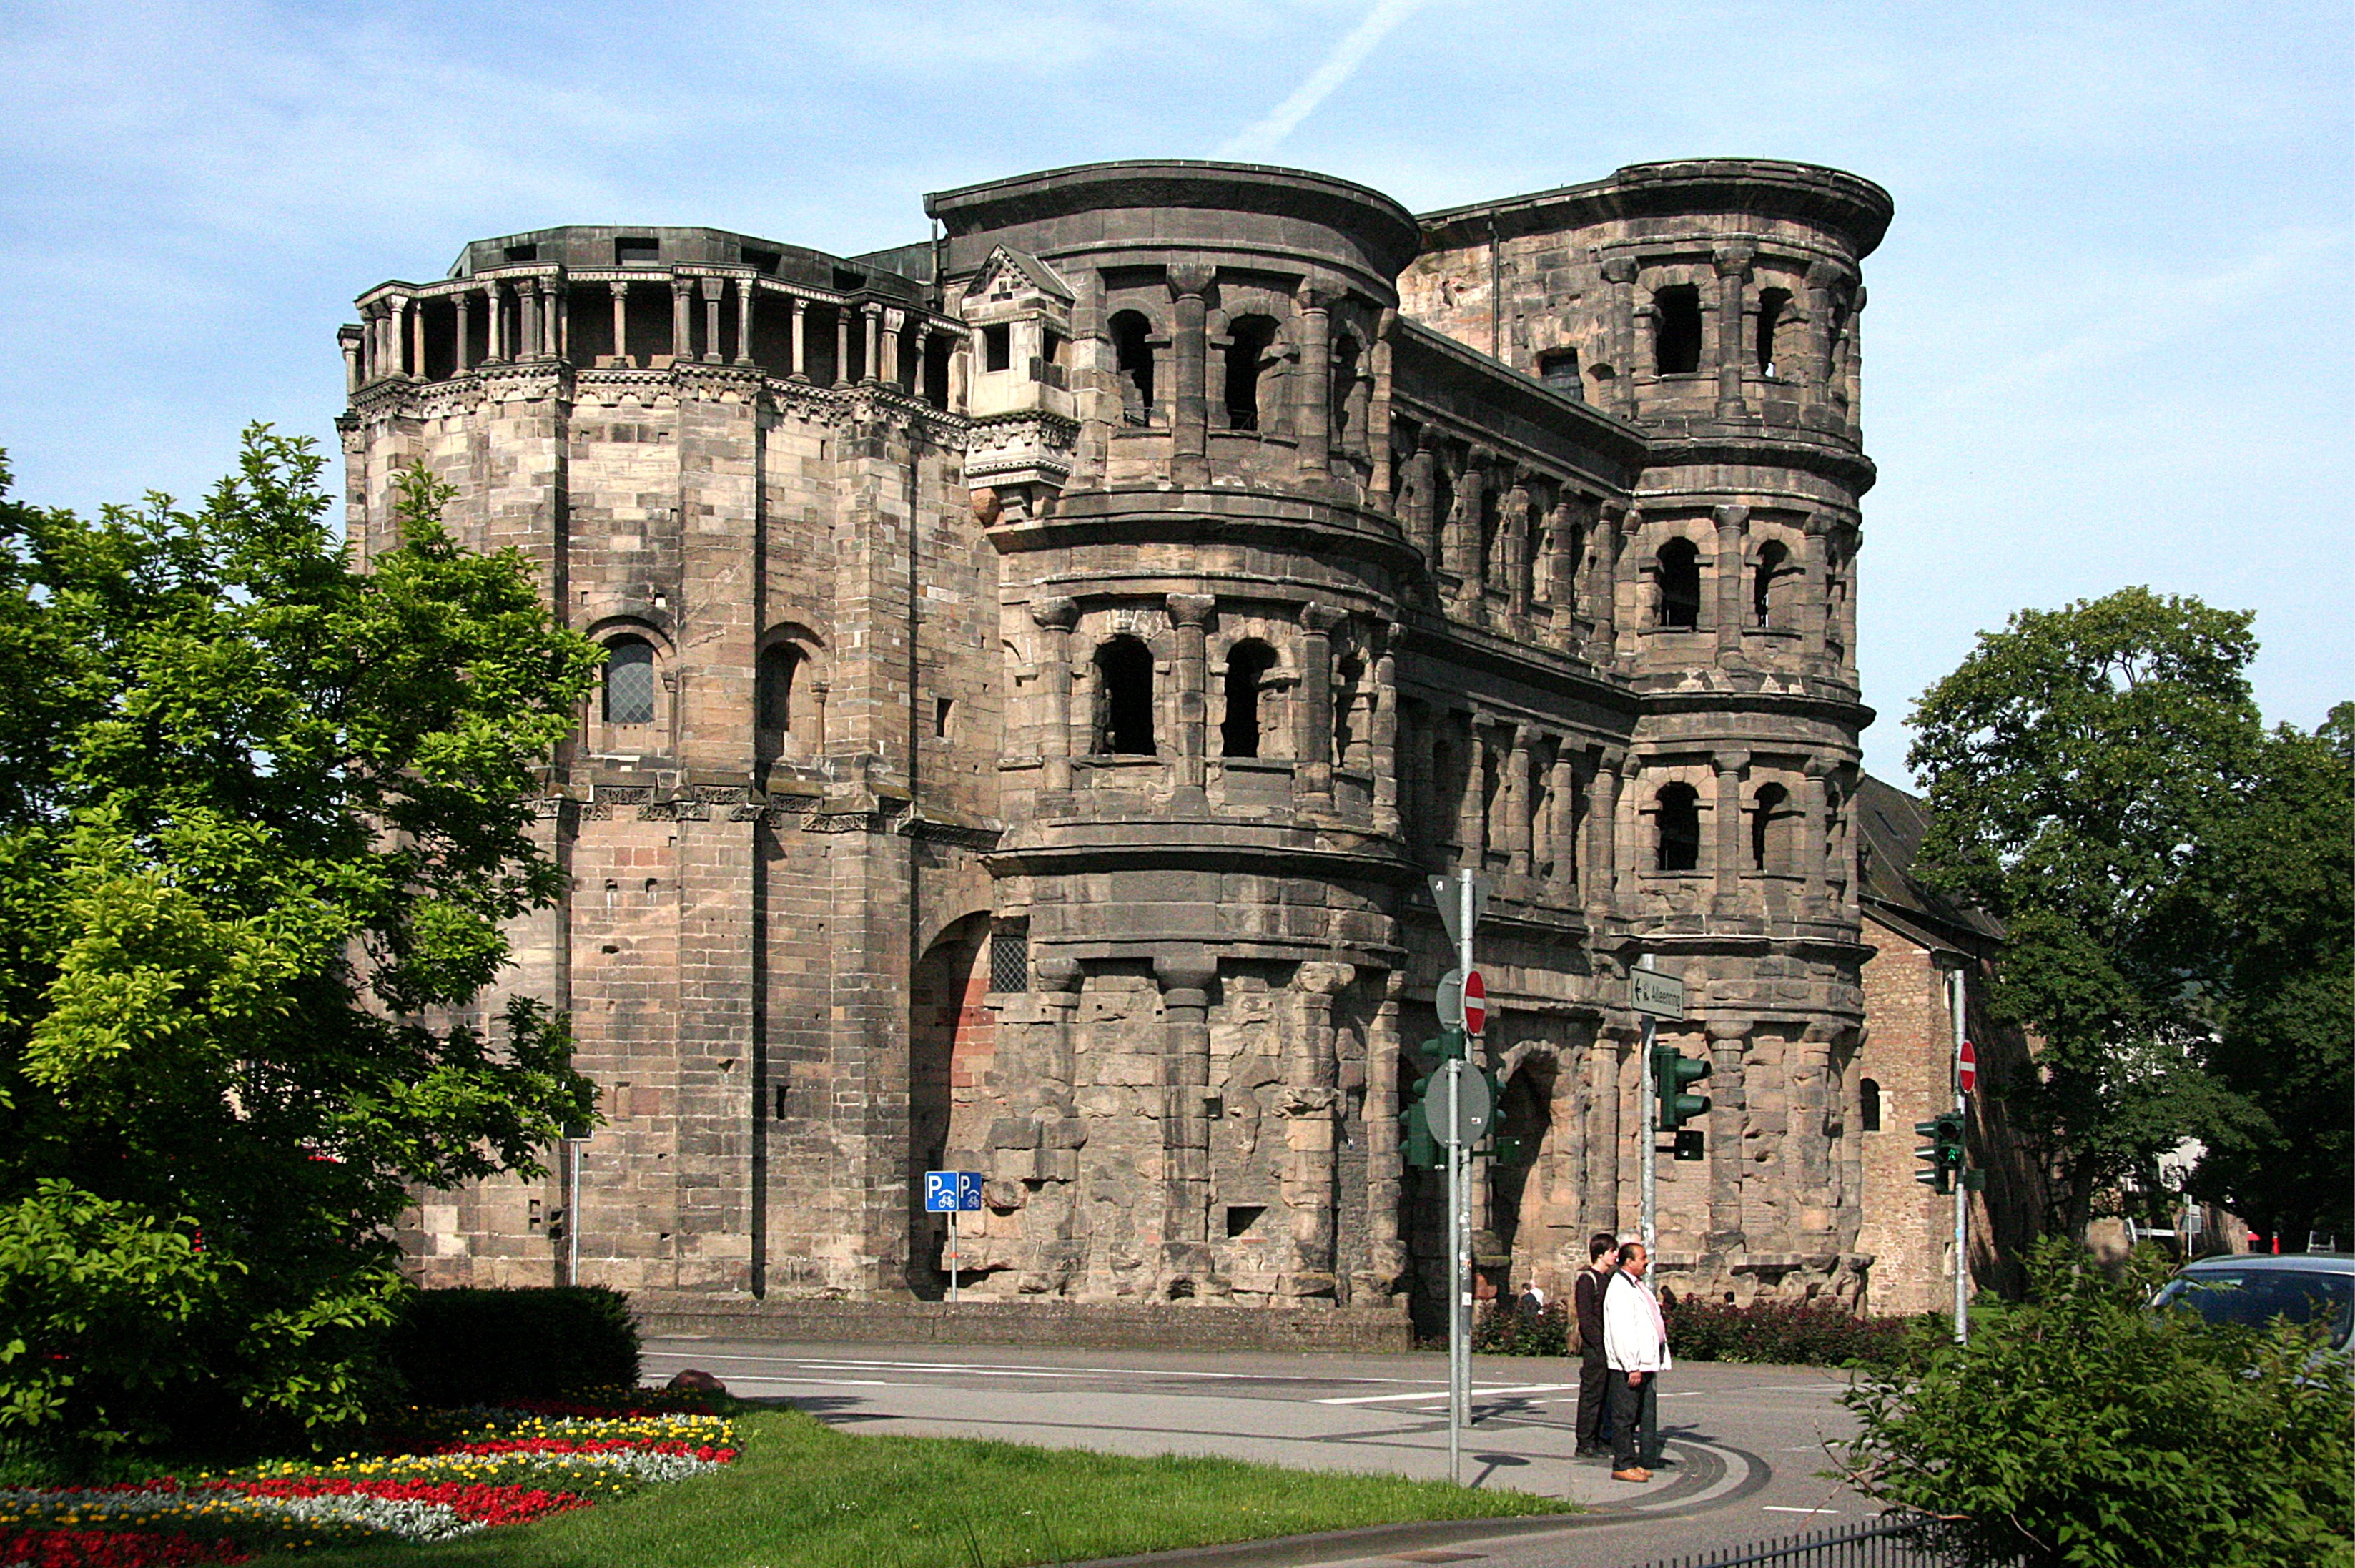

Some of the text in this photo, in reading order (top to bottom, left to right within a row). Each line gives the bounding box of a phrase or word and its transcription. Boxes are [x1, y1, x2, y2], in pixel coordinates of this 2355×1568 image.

[1652, 985, 1680, 1012] Alleenring
[929, 1175, 942, 1199] P
[960, 1175, 970, 1198] P
